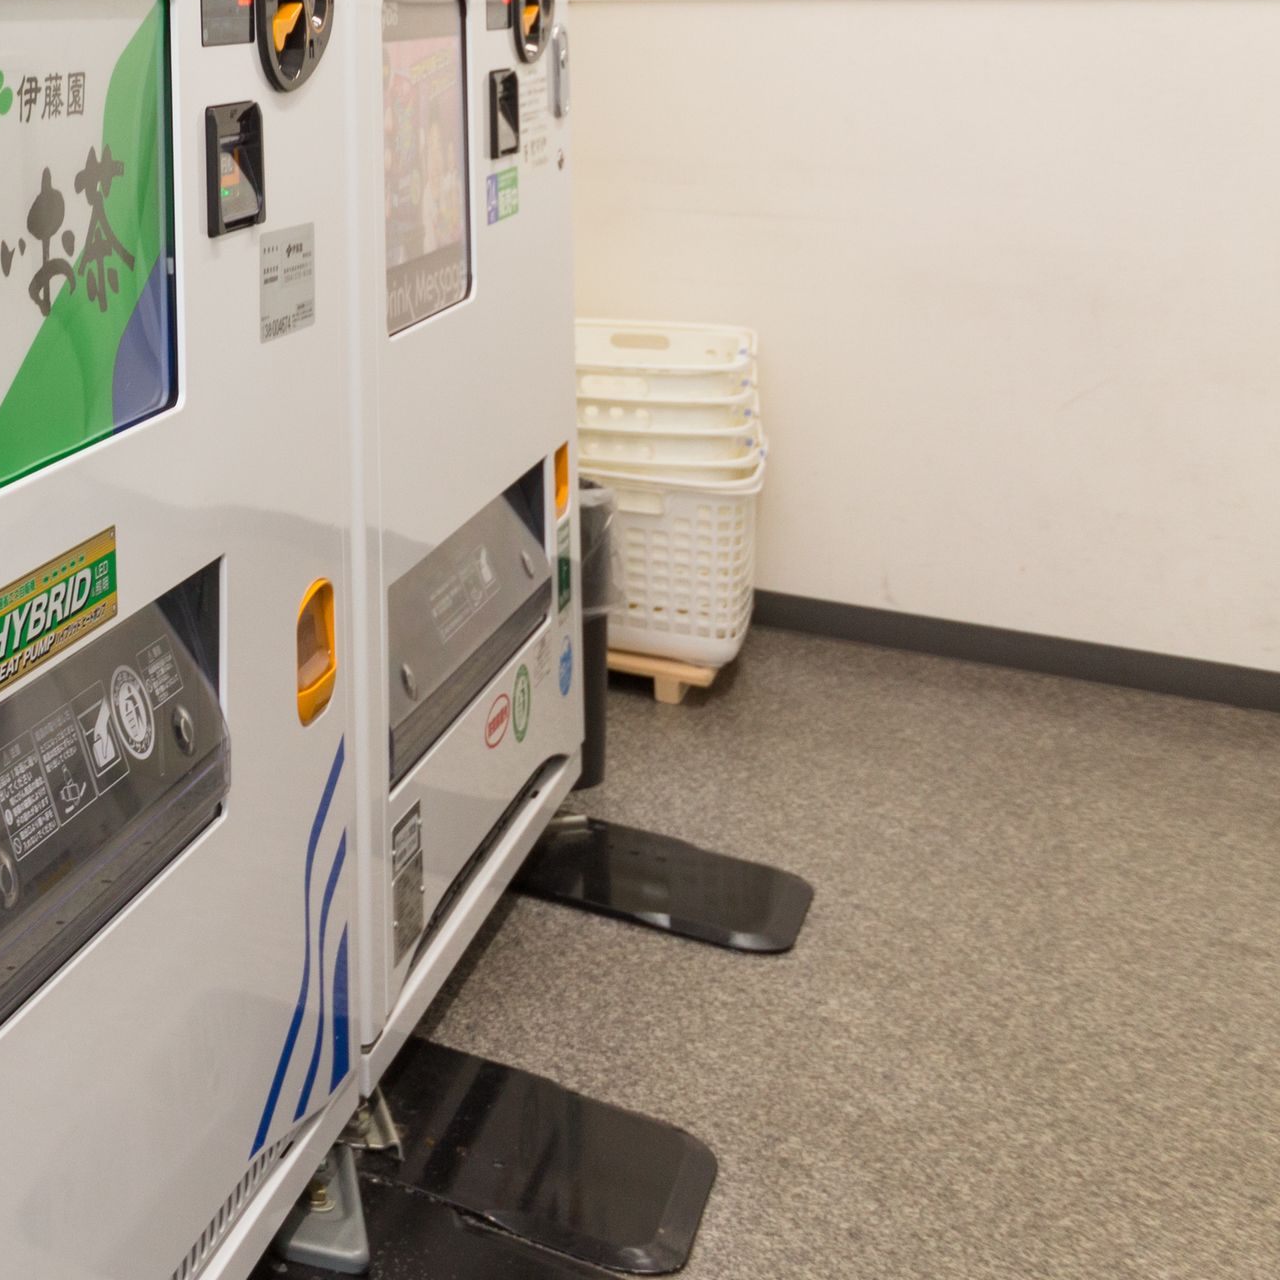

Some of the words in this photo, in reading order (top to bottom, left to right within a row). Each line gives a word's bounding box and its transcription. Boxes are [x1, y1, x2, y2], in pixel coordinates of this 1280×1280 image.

[17, 71, 86, 123] 伊藤園
[23, 632, 56, 669] PUMP
